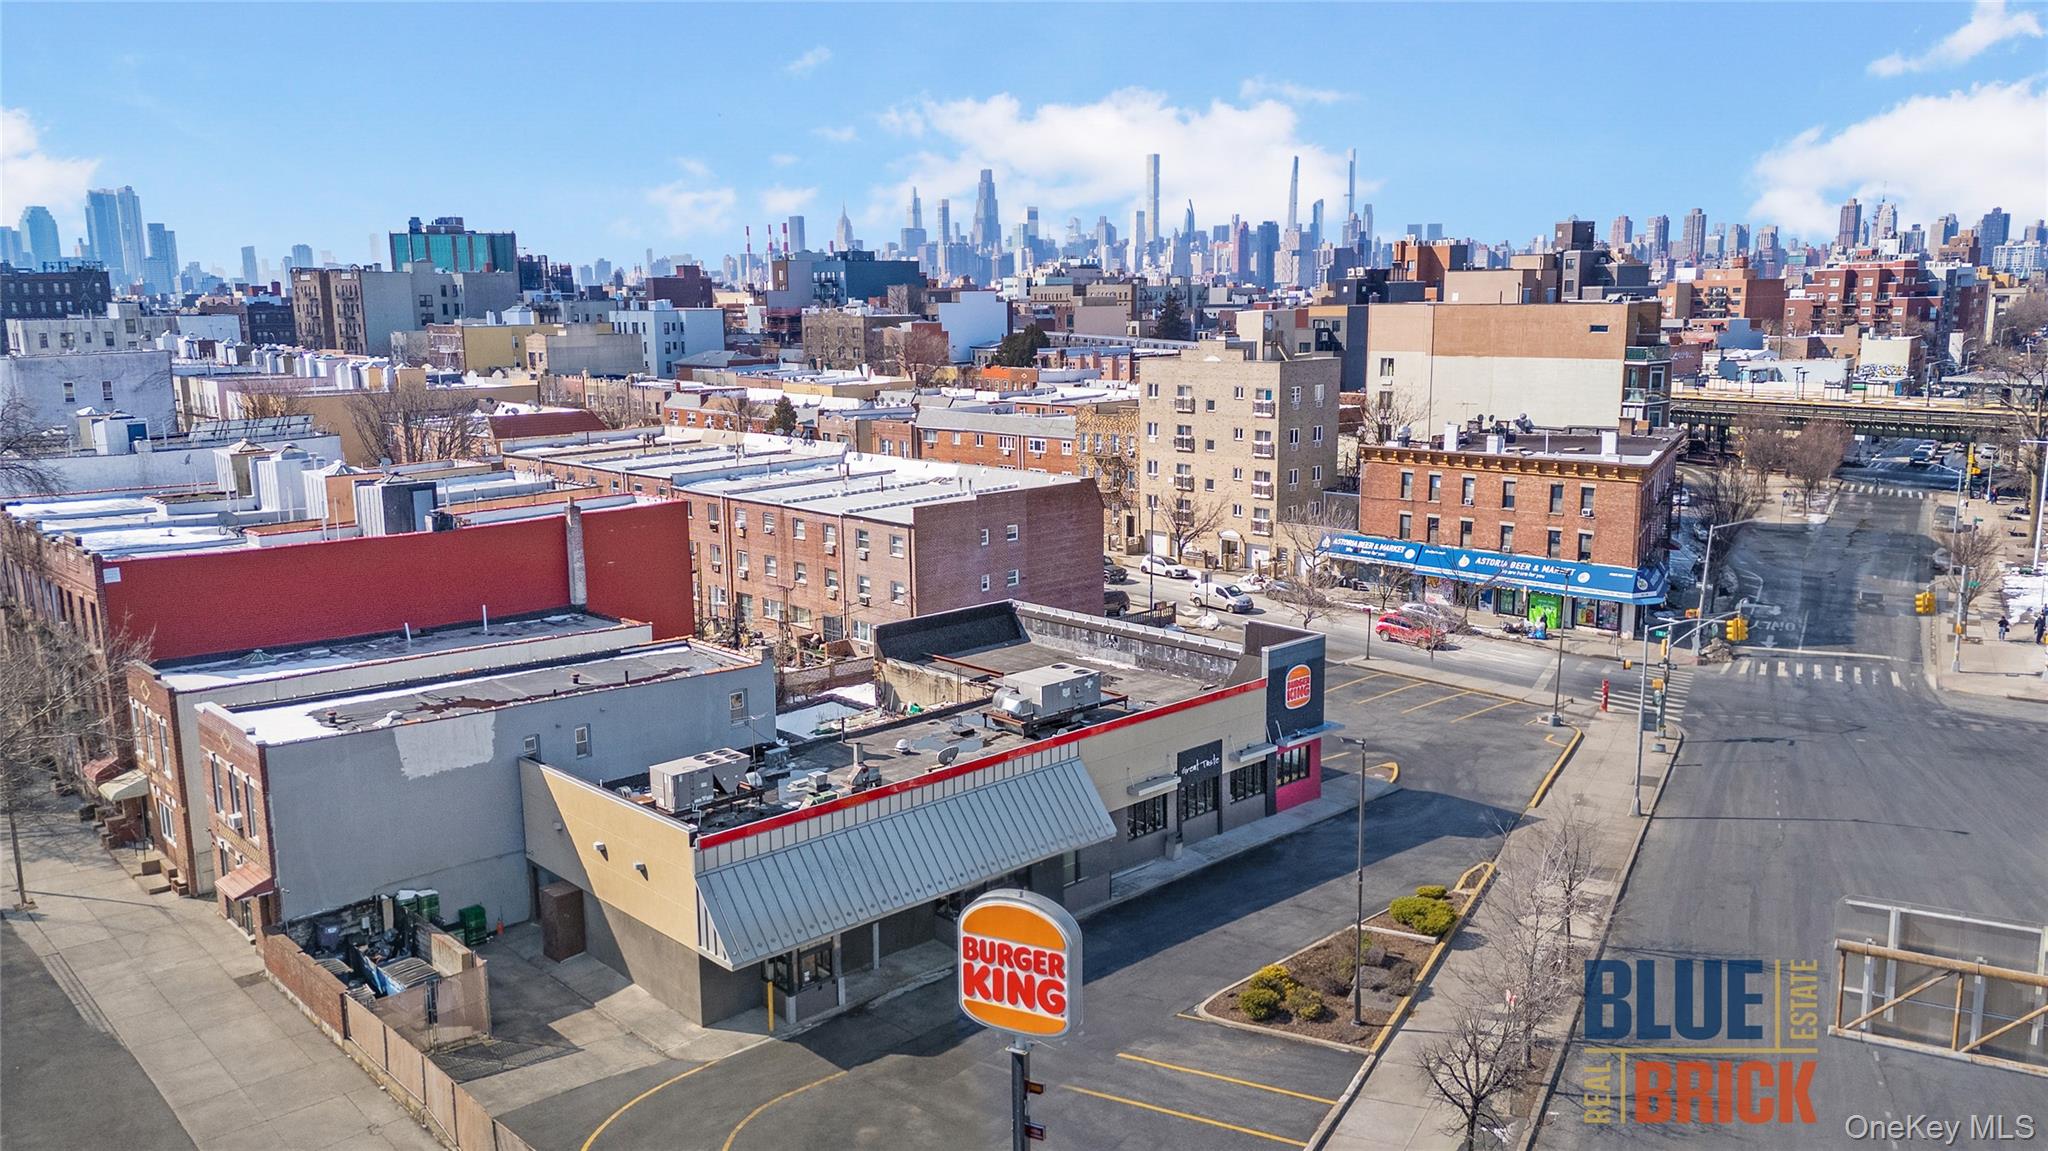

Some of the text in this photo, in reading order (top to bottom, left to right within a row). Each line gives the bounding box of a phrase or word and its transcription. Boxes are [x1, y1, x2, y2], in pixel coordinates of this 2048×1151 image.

[1333, 537, 1357, 547] ASTORIA
[1358, 540, 1373, 549] BEER
[1380, 543, 1406, 553] MARKET
[1475, 557, 1508, 567] ASTORIA
[1510, 561, 1531, 571] BEER
[1533, 564, 1539, 572] &
[1748, 620, 1796, 631] ONLY
[1287, 677, 1310, 690] BURGER
[1287, 685, 1310, 702] KING
[963, 936, 1066, 979] BURGER
[963, 962, 1067, 1014] KING
